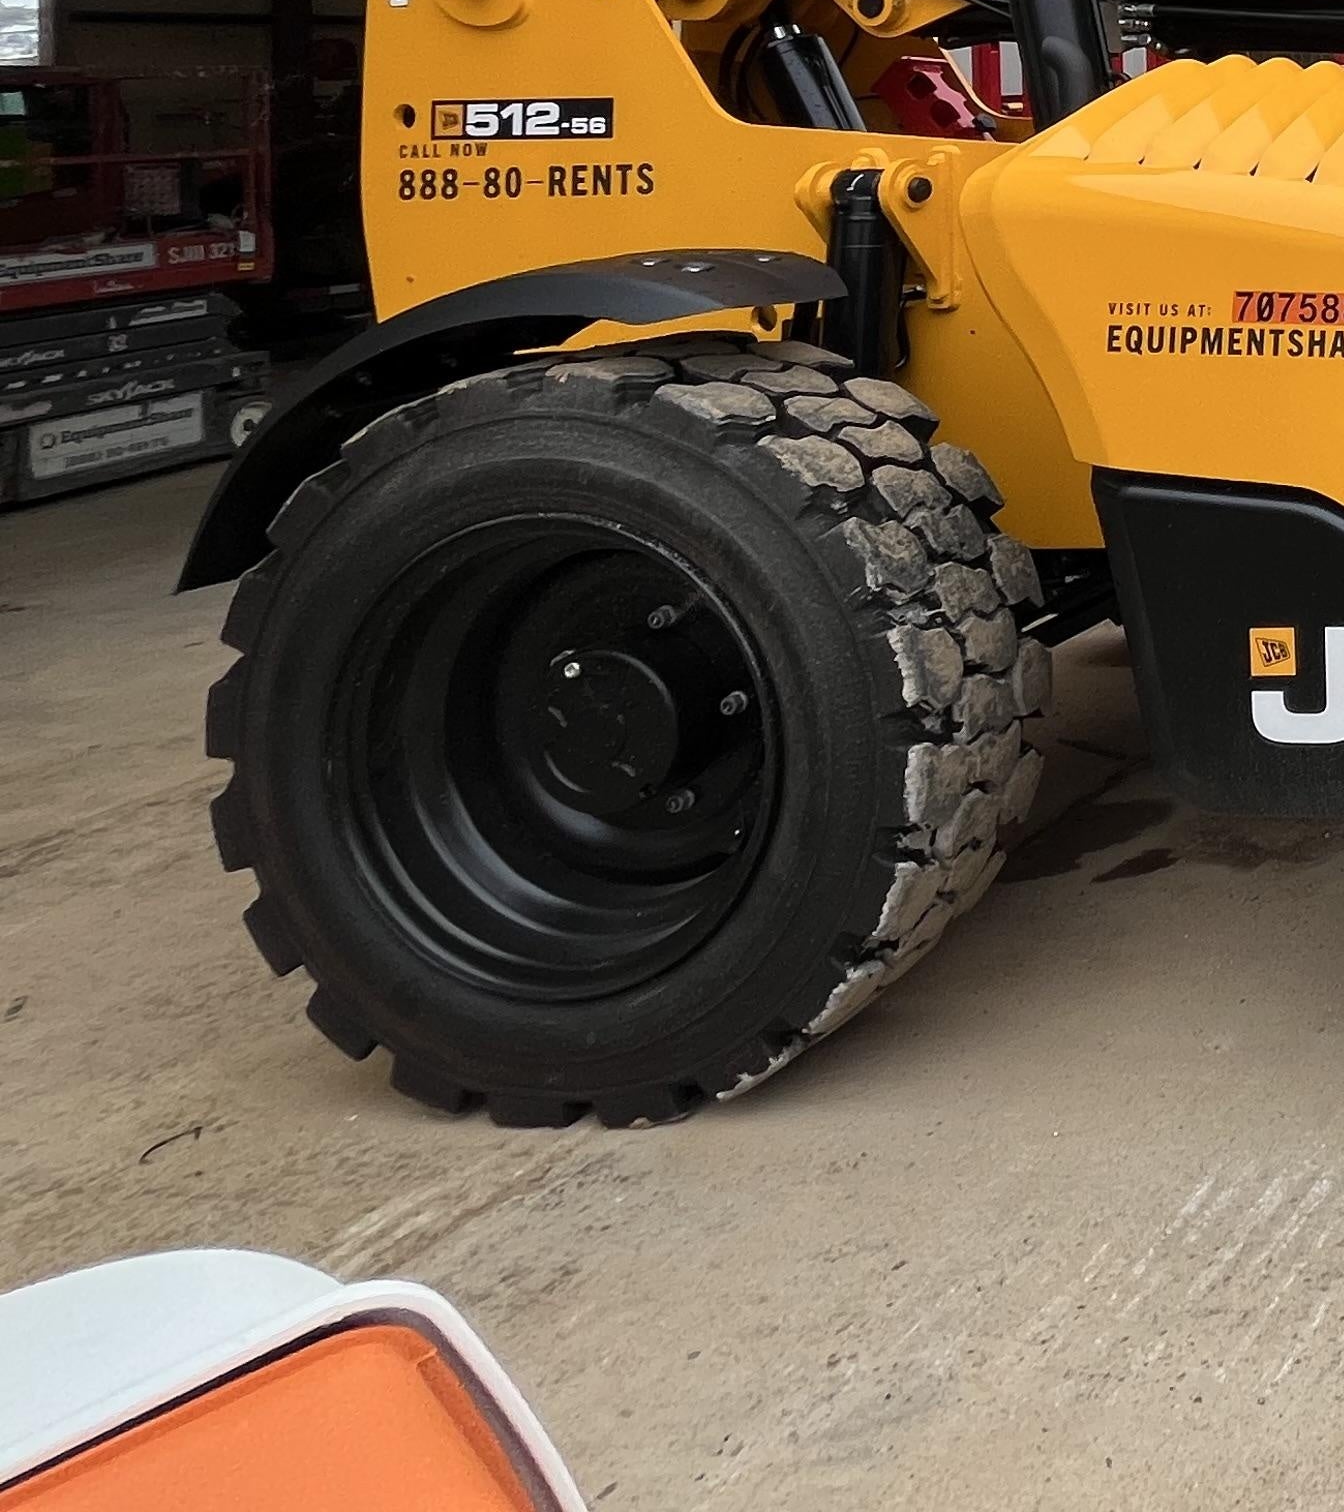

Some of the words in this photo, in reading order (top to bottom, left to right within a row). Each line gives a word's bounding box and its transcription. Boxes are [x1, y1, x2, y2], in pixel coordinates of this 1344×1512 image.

[398, 144, 442, 159] CALL
[450, 142, 488, 157] NOW
[398, 162, 655, 201] 888-80-RENTS
[1108, 302, 1151, 317] VISIT
[1160, 303, 1179, 317] US
[1187, 304, 1212, 318] AT:
[1260, 638, 1291, 665] JCB
